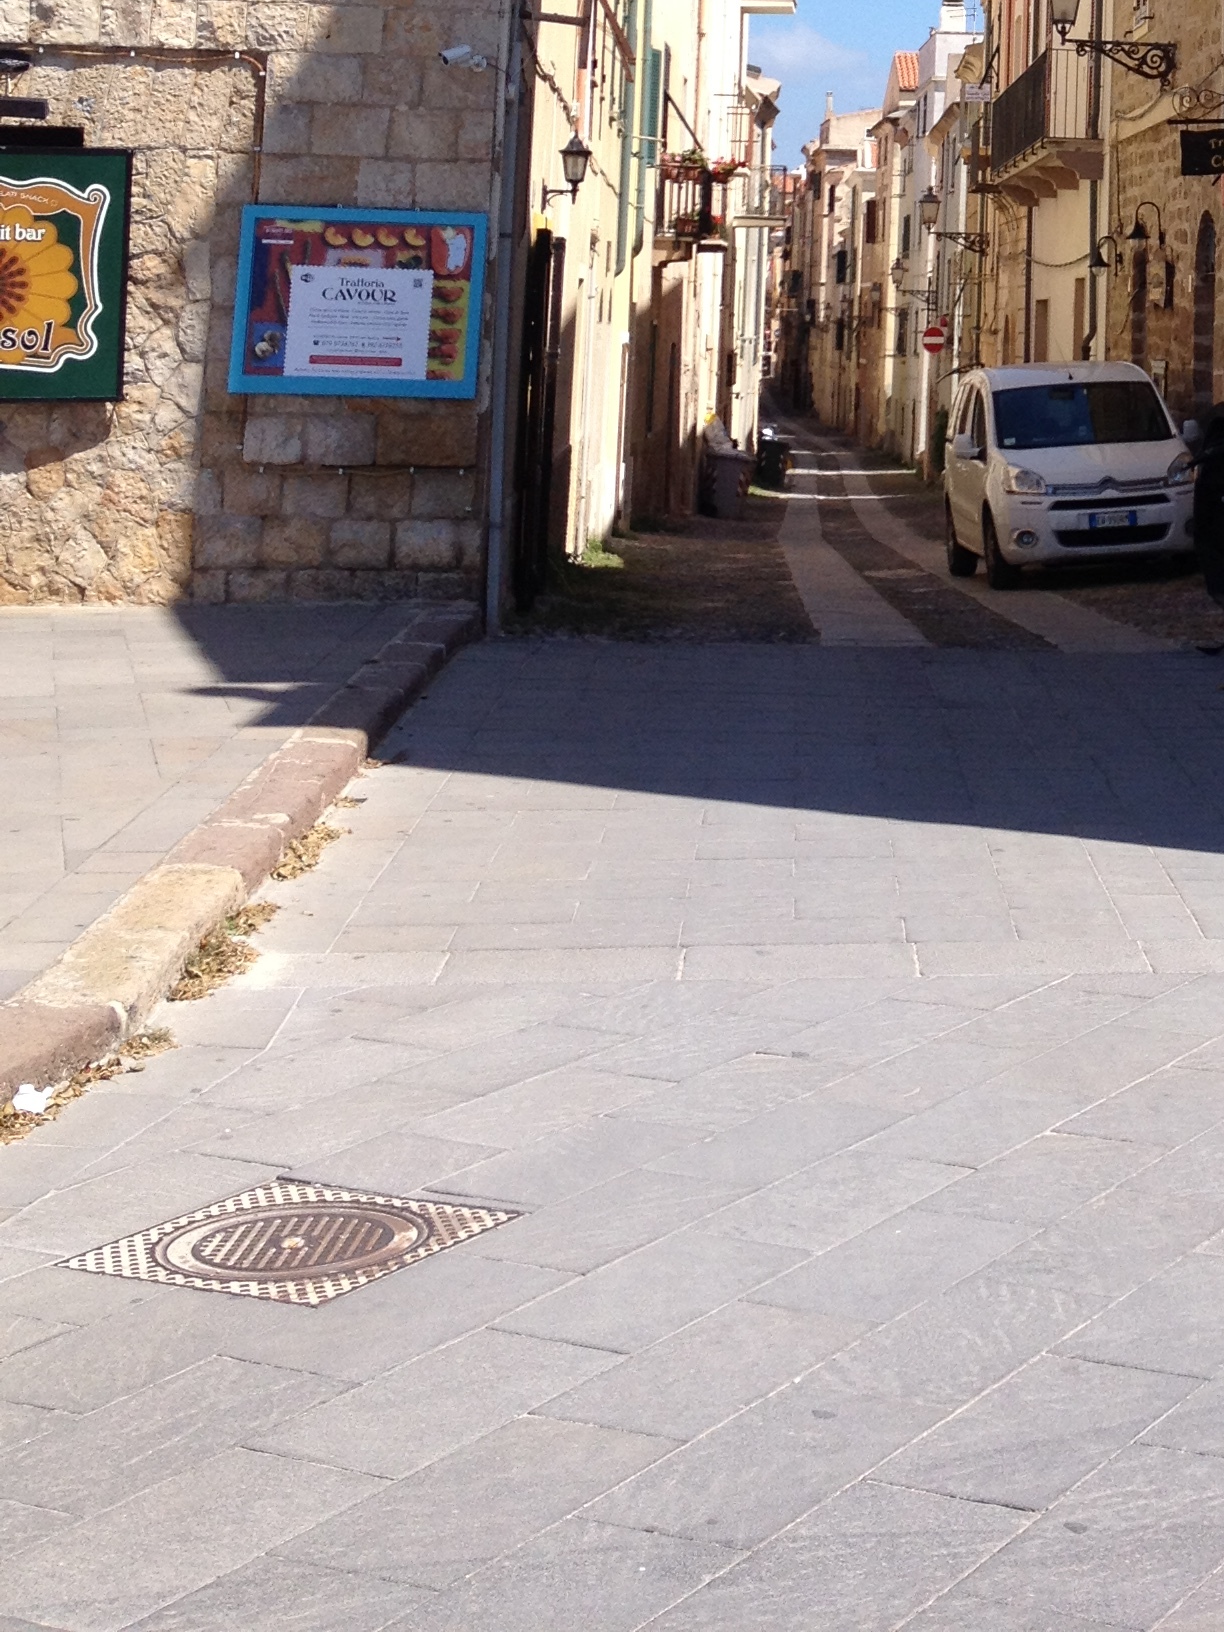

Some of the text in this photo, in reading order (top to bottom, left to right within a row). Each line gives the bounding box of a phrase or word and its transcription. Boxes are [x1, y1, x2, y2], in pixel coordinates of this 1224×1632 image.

[15, 223, 46, 241] bar
[340, 277, 385, 288] Trattoria
[321, 287, 397, 303] CAVOUR
[0, 319, 54, 354] sol
